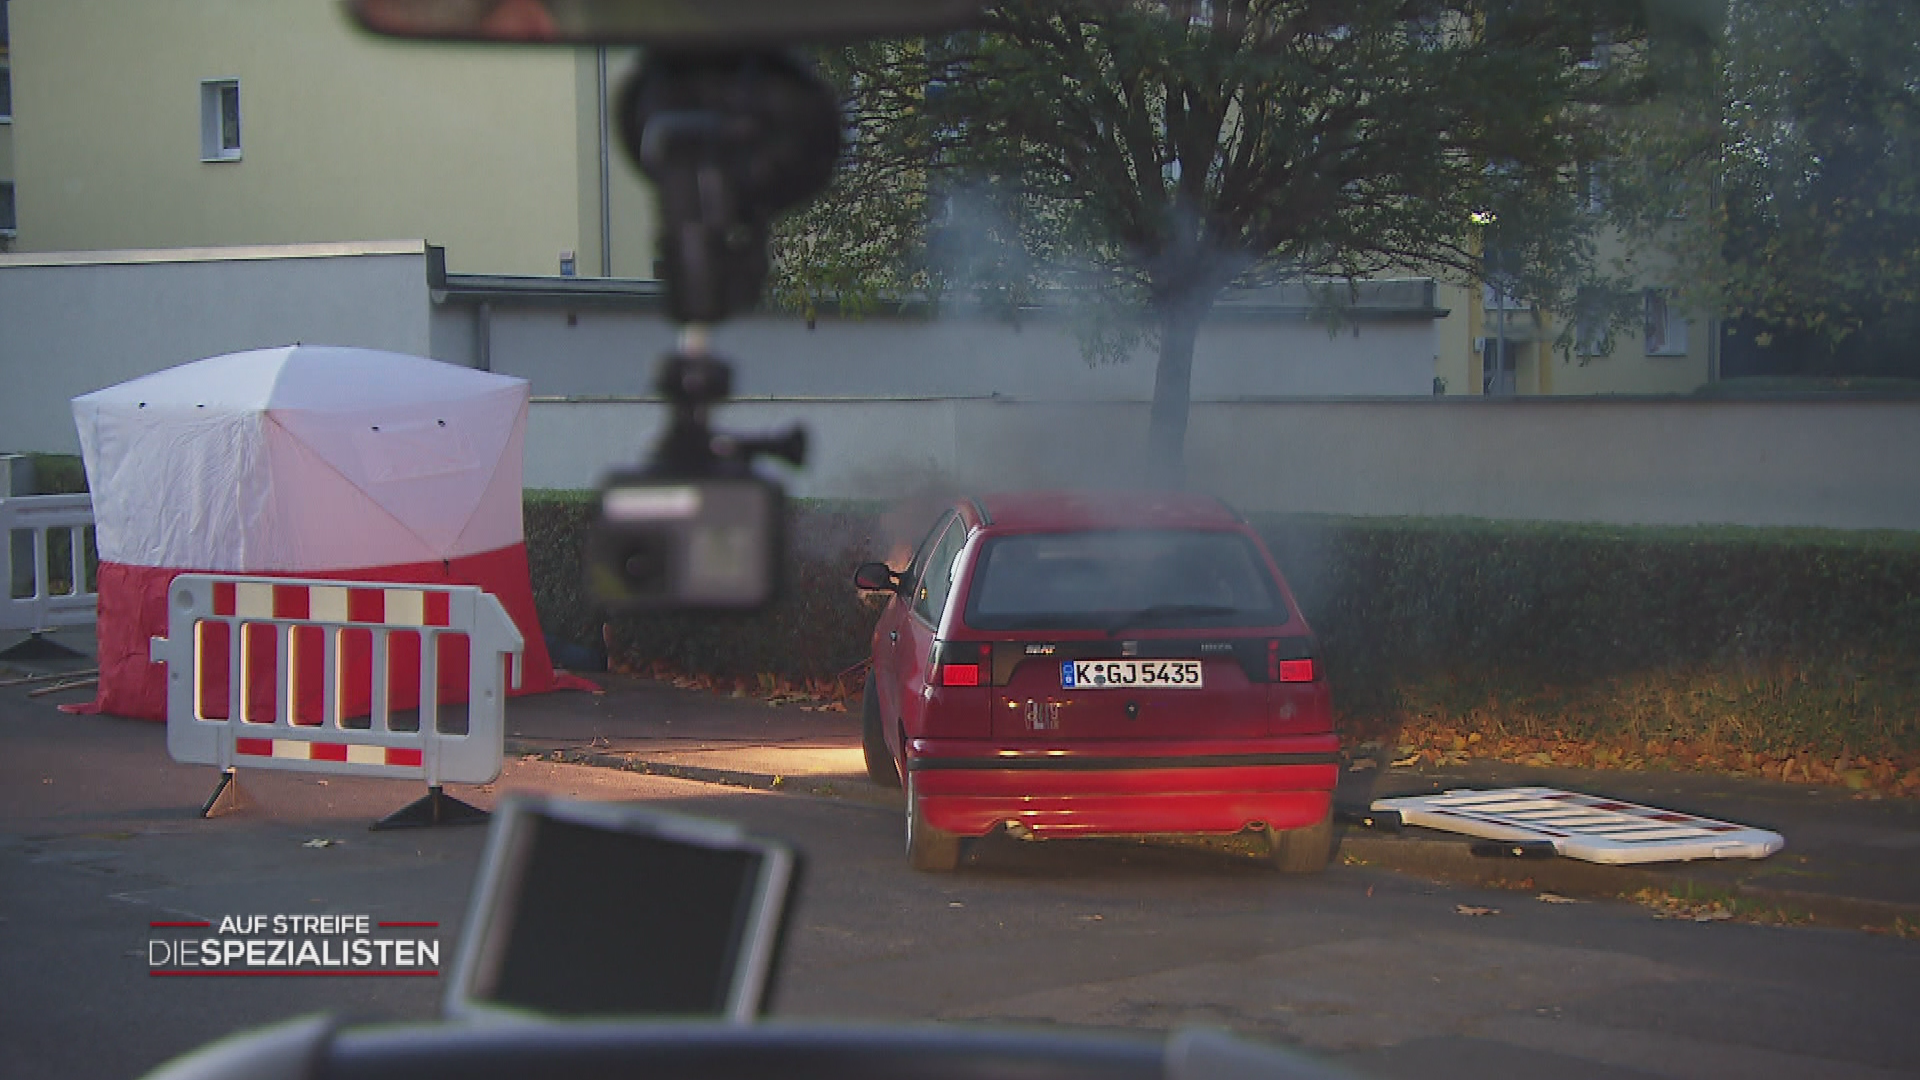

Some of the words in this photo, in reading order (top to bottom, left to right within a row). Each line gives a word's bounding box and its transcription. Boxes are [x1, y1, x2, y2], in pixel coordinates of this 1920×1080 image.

[1077, 664, 1091, 683] K
[1107, 664, 1137, 683] GJ
[1142, 664, 1199, 683] 5435
